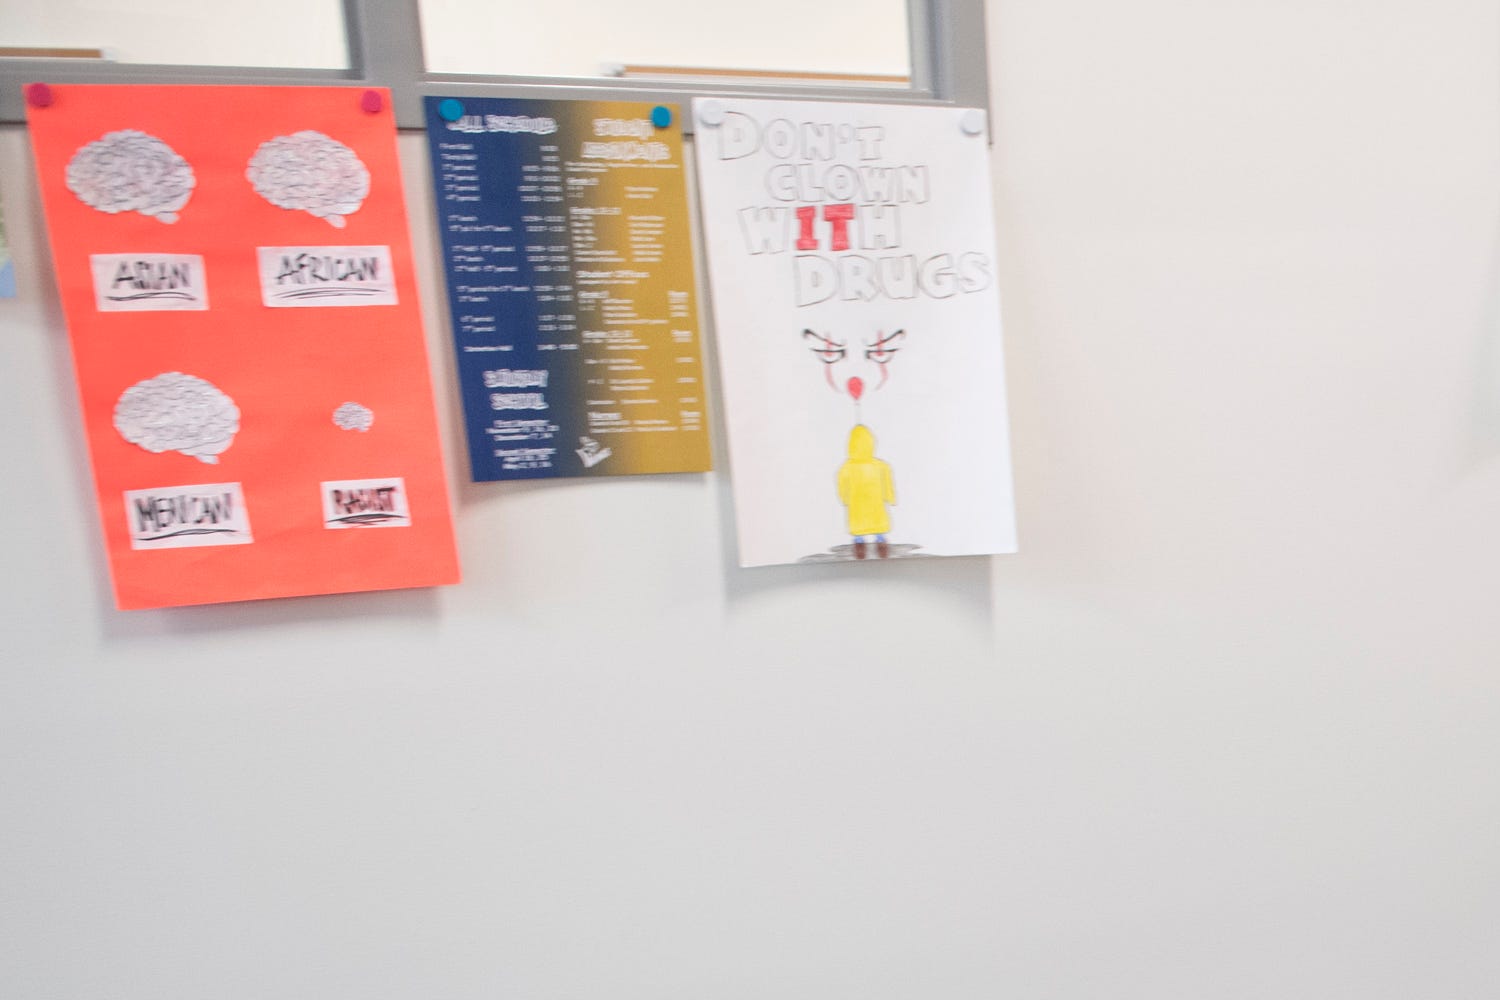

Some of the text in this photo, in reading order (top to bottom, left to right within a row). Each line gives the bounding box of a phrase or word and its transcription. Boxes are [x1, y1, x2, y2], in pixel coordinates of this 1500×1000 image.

[717, 110, 886, 162] DON'T
[763, 163, 931, 205] CLOWN
[737, 203, 902, 256] WITH
[110, 260, 191, 290] ASIAN
[274, 252, 379, 286] AFRICAN
[792, 250, 994, 308] DRUGS
[132, 492, 234, 532] MEXICAN
